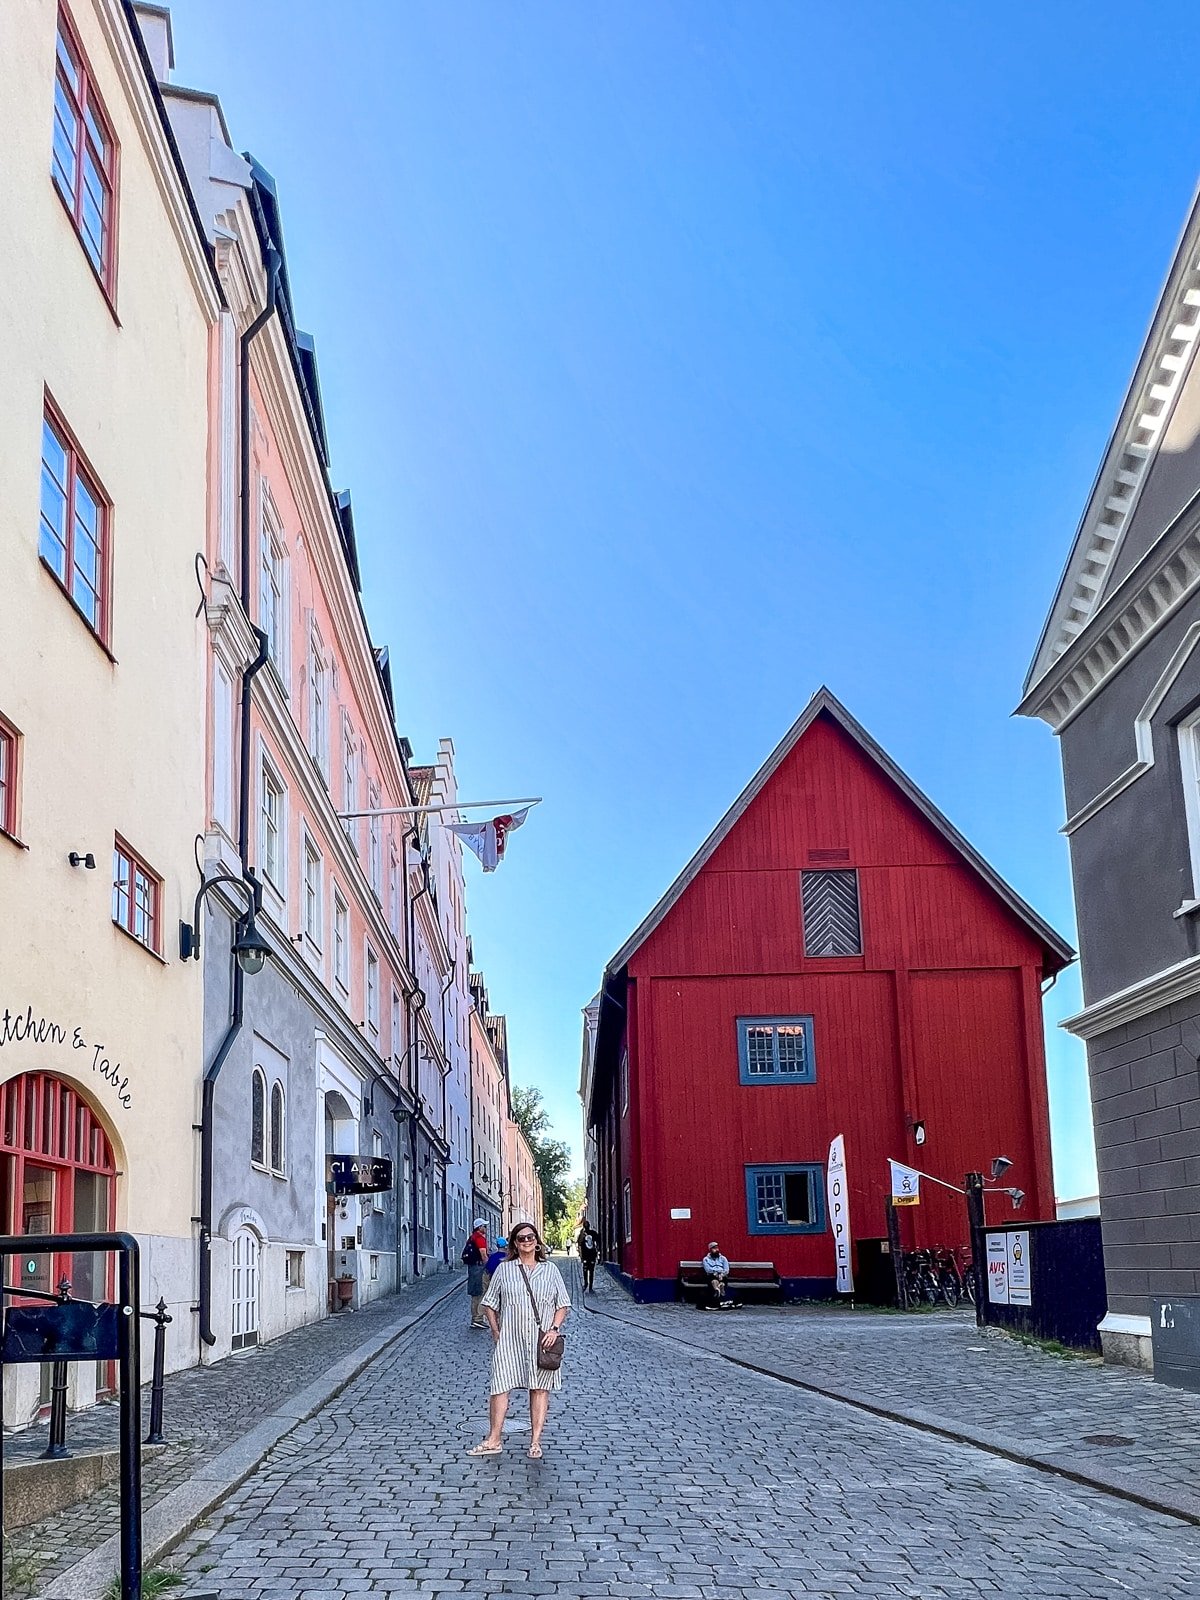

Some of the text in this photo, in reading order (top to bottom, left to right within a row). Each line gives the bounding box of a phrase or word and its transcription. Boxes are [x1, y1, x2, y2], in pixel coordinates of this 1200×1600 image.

[72, 1026, 87, 1049] &
[92, 1044, 132, 1110] Table
[330, 1161, 387, 1178] CLARI
[832, 1178, 848, 1280] ÖPPET
[989, 1261, 1006, 1274] AVIS
